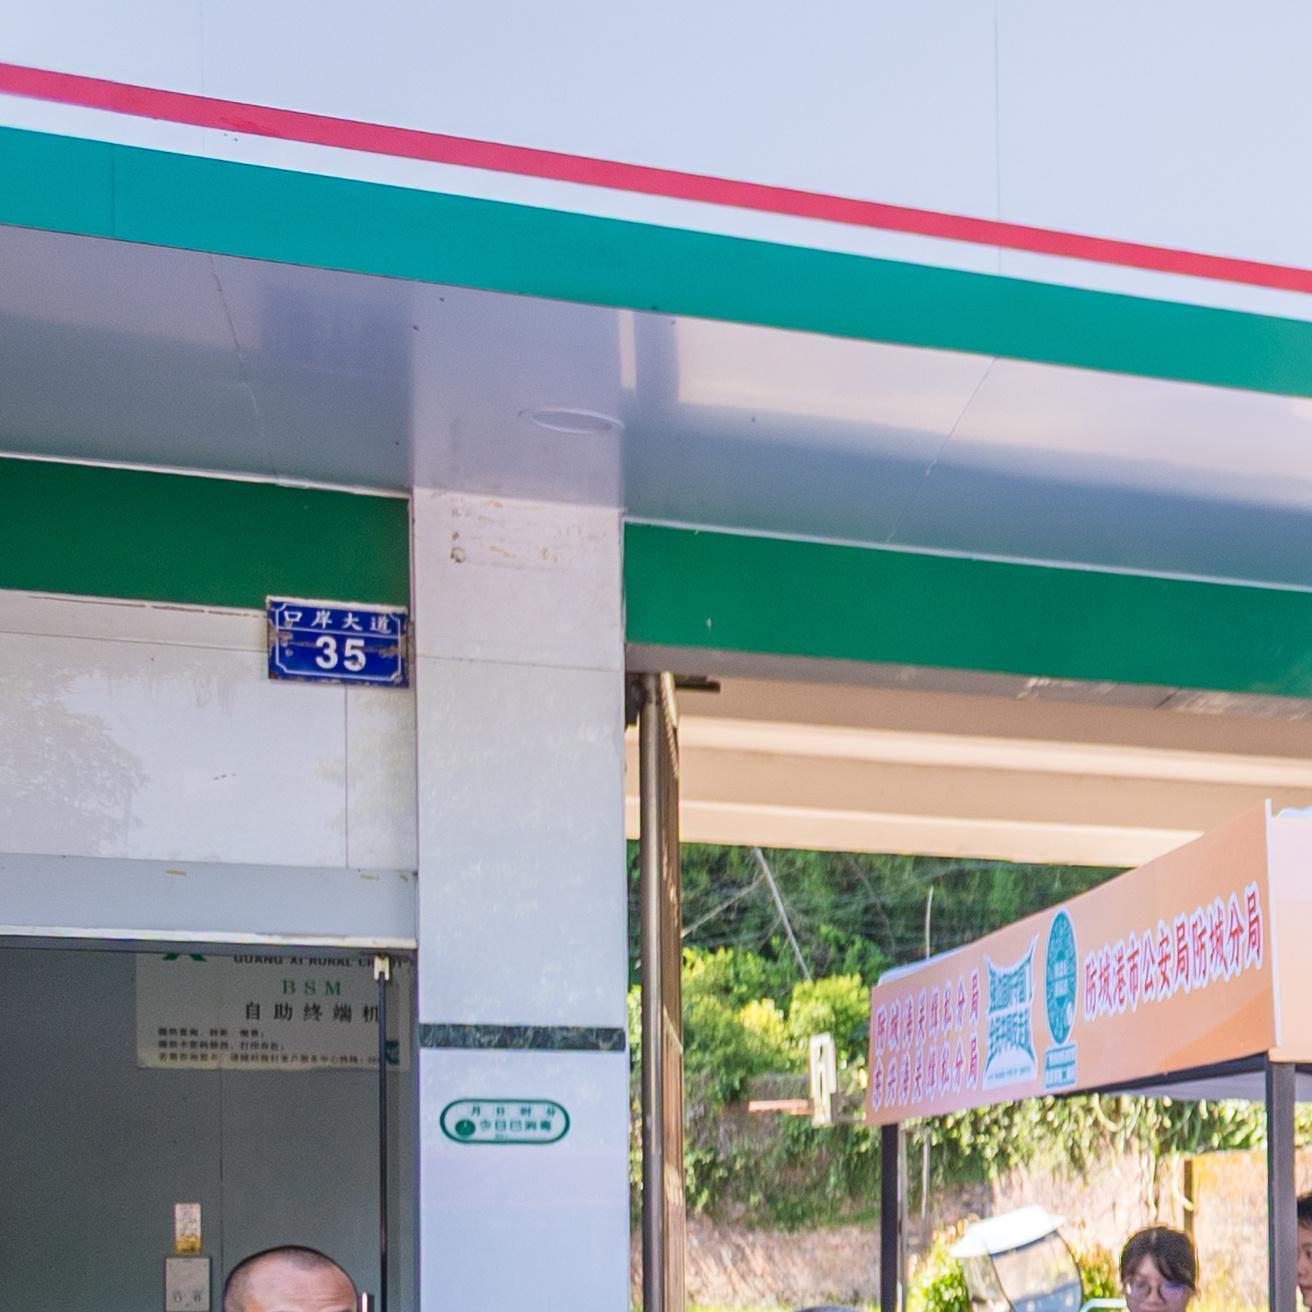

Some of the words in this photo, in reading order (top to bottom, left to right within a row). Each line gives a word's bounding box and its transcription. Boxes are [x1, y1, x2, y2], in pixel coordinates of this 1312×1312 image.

[284, 609, 391, 634] 口岸大道
[315, 635, 366, 672] 35
[1085, 890, 1261, 1014] 防城港市公安局防城分局
[245, 1001, 380, 1023] 自助终端机
